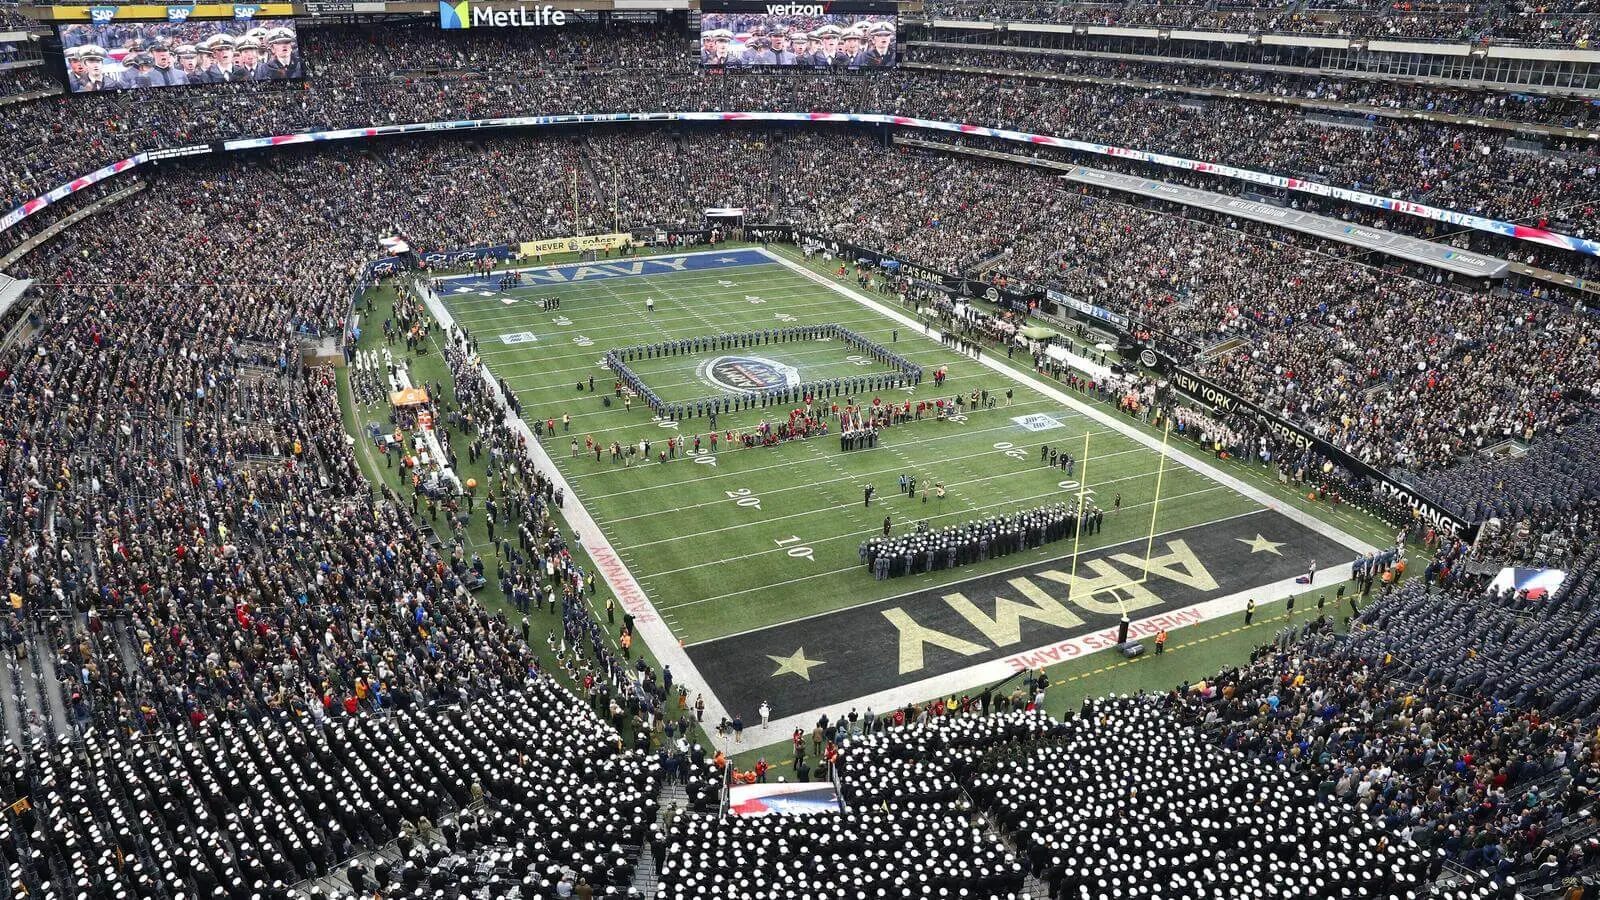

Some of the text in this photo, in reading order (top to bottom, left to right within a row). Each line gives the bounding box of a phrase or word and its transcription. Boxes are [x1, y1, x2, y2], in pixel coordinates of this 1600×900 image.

[91, 9, 114, 21] SAP
[168, 8, 190, 19] SAP
[234, 7, 255, 18] SAP
[473, 5, 566, 27] MetLife
[766, 1, 824, 16] verizon
[1228, 199, 1288, 218] METLIFE STADIUM
[1295, 180, 1320, 194] THE
[1390, 199, 1416, 214] THE
[1424, 207, 1473, 227] BRAVE
[535, 242, 564, 252] NEVER
[519, 257, 688, 285] NAVY
[1456, 254, 1487, 267] MetLife
[920, 270, 943, 285] GAME
[1174, 372, 1199, 393] NEW
[1201, 386, 1230, 410] YORK
[1381, 480, 1464, 537] EXCHANGE
[774, 535, 814, 558] 10
[590, 547, 657, 623] #ARMYNAVY
[881, 538, 1220, 675] ARMY
[1004, 607, 1204, 672] AMERICA'S GAME
